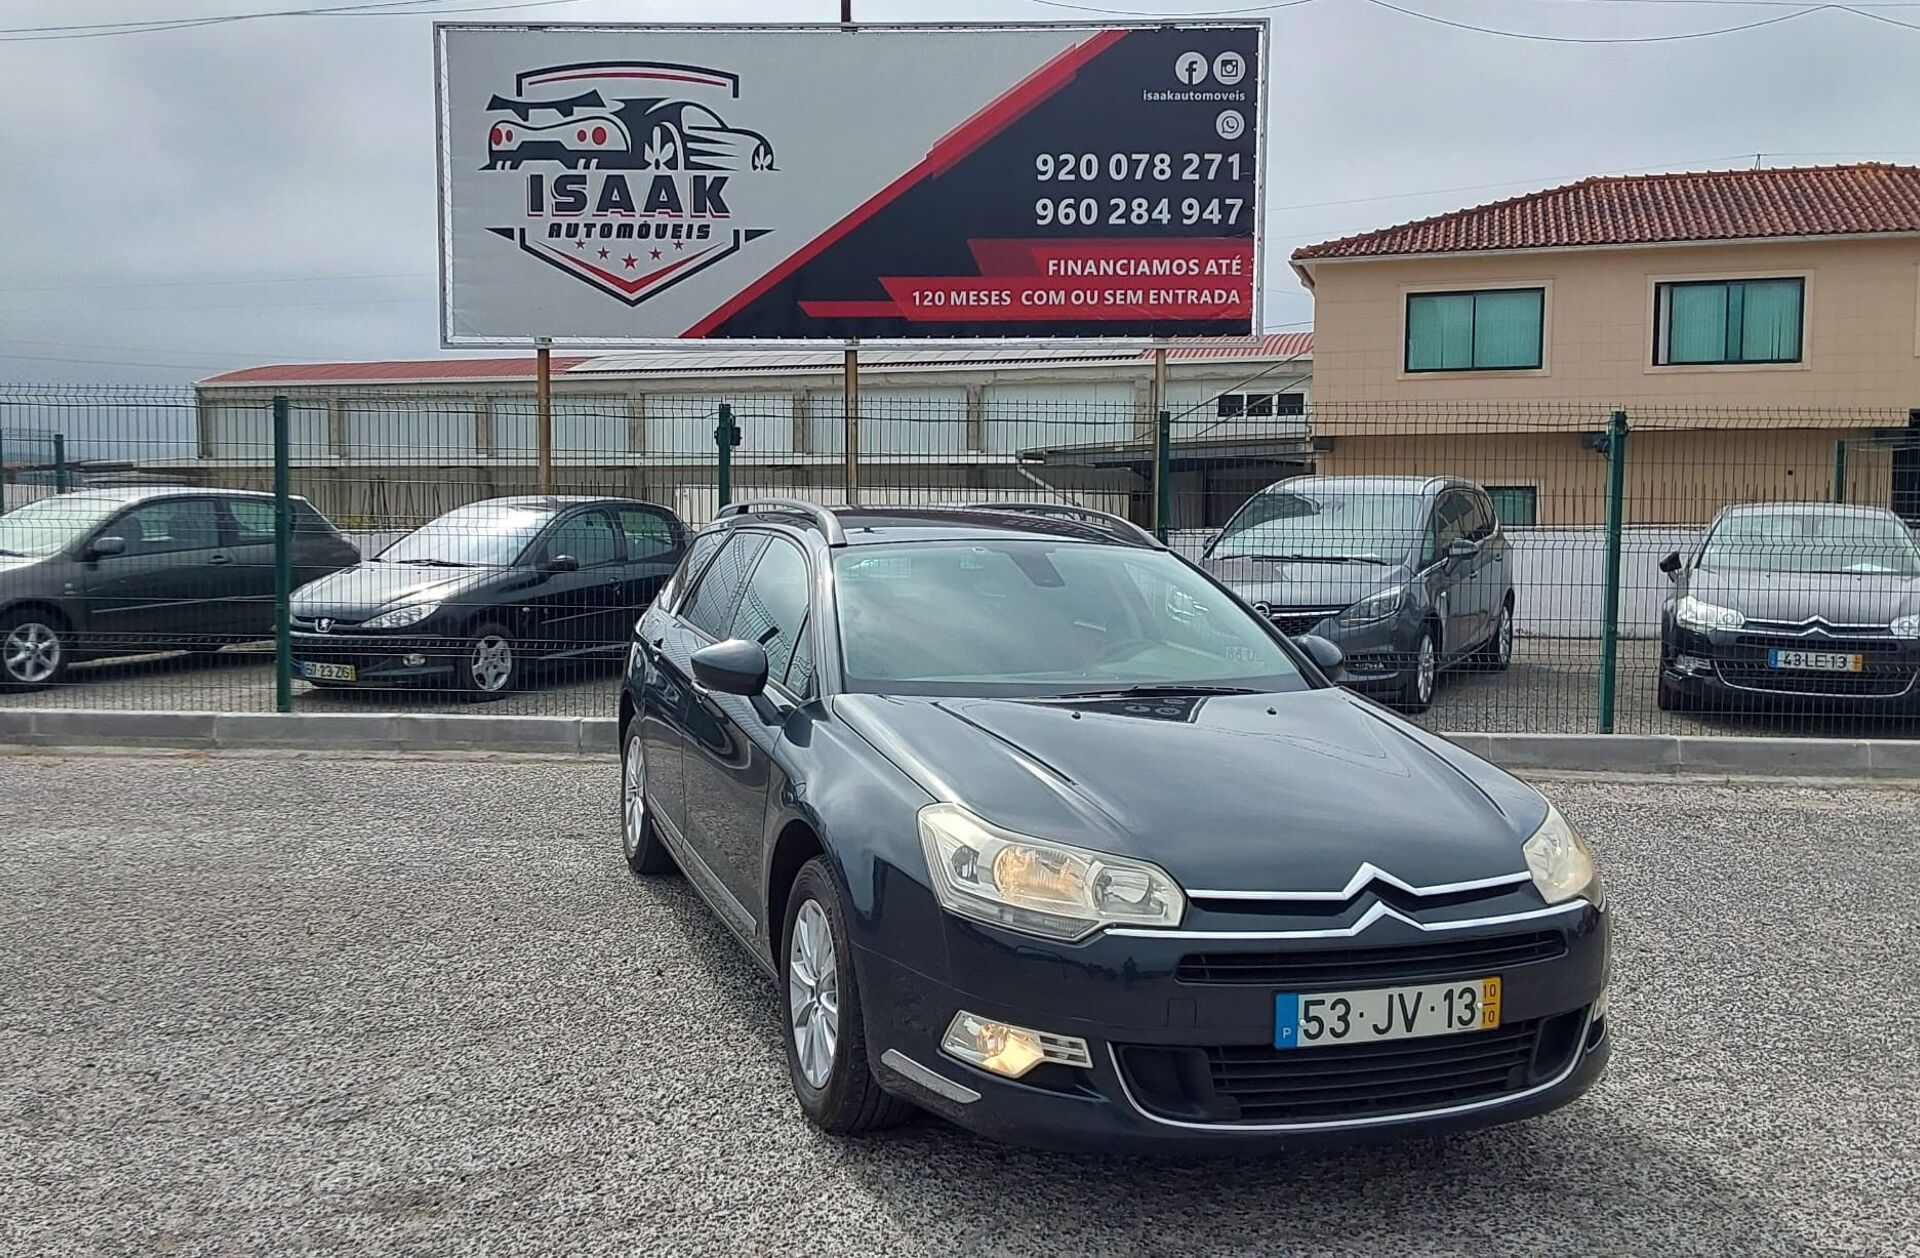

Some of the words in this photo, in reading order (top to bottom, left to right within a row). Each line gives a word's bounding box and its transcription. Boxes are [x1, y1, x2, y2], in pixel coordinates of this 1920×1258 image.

[1143, 89, 1246, 101] isaakautomoveis
[1035, 153, 1099, 181] 920
[1109, 153, 1172, 181] 078
[1181, 153, 1241, 181] 271
[526, 173, 731, 218] ISAAK
[1035, 198, 1098, 225] 960
[1108, 198, 1171, 225] 284
[1181, 198, 1243, 225] 947
[1048, 259, 1200, 276] FINANCIAMOS
[1204, 255, 1242, 276] ATÉ
[912, 290, 945, 306] 120
[950, 290, 1011, 306] MESES
[1021, 290, 1065, 306] COM
[1070, 289, 1098, 305] OU
[1104, 289, 1142, 305] SEM
[1149, 289, 1241, 305] ENTRADA
[1283, 1027, 1292, 1039] P
